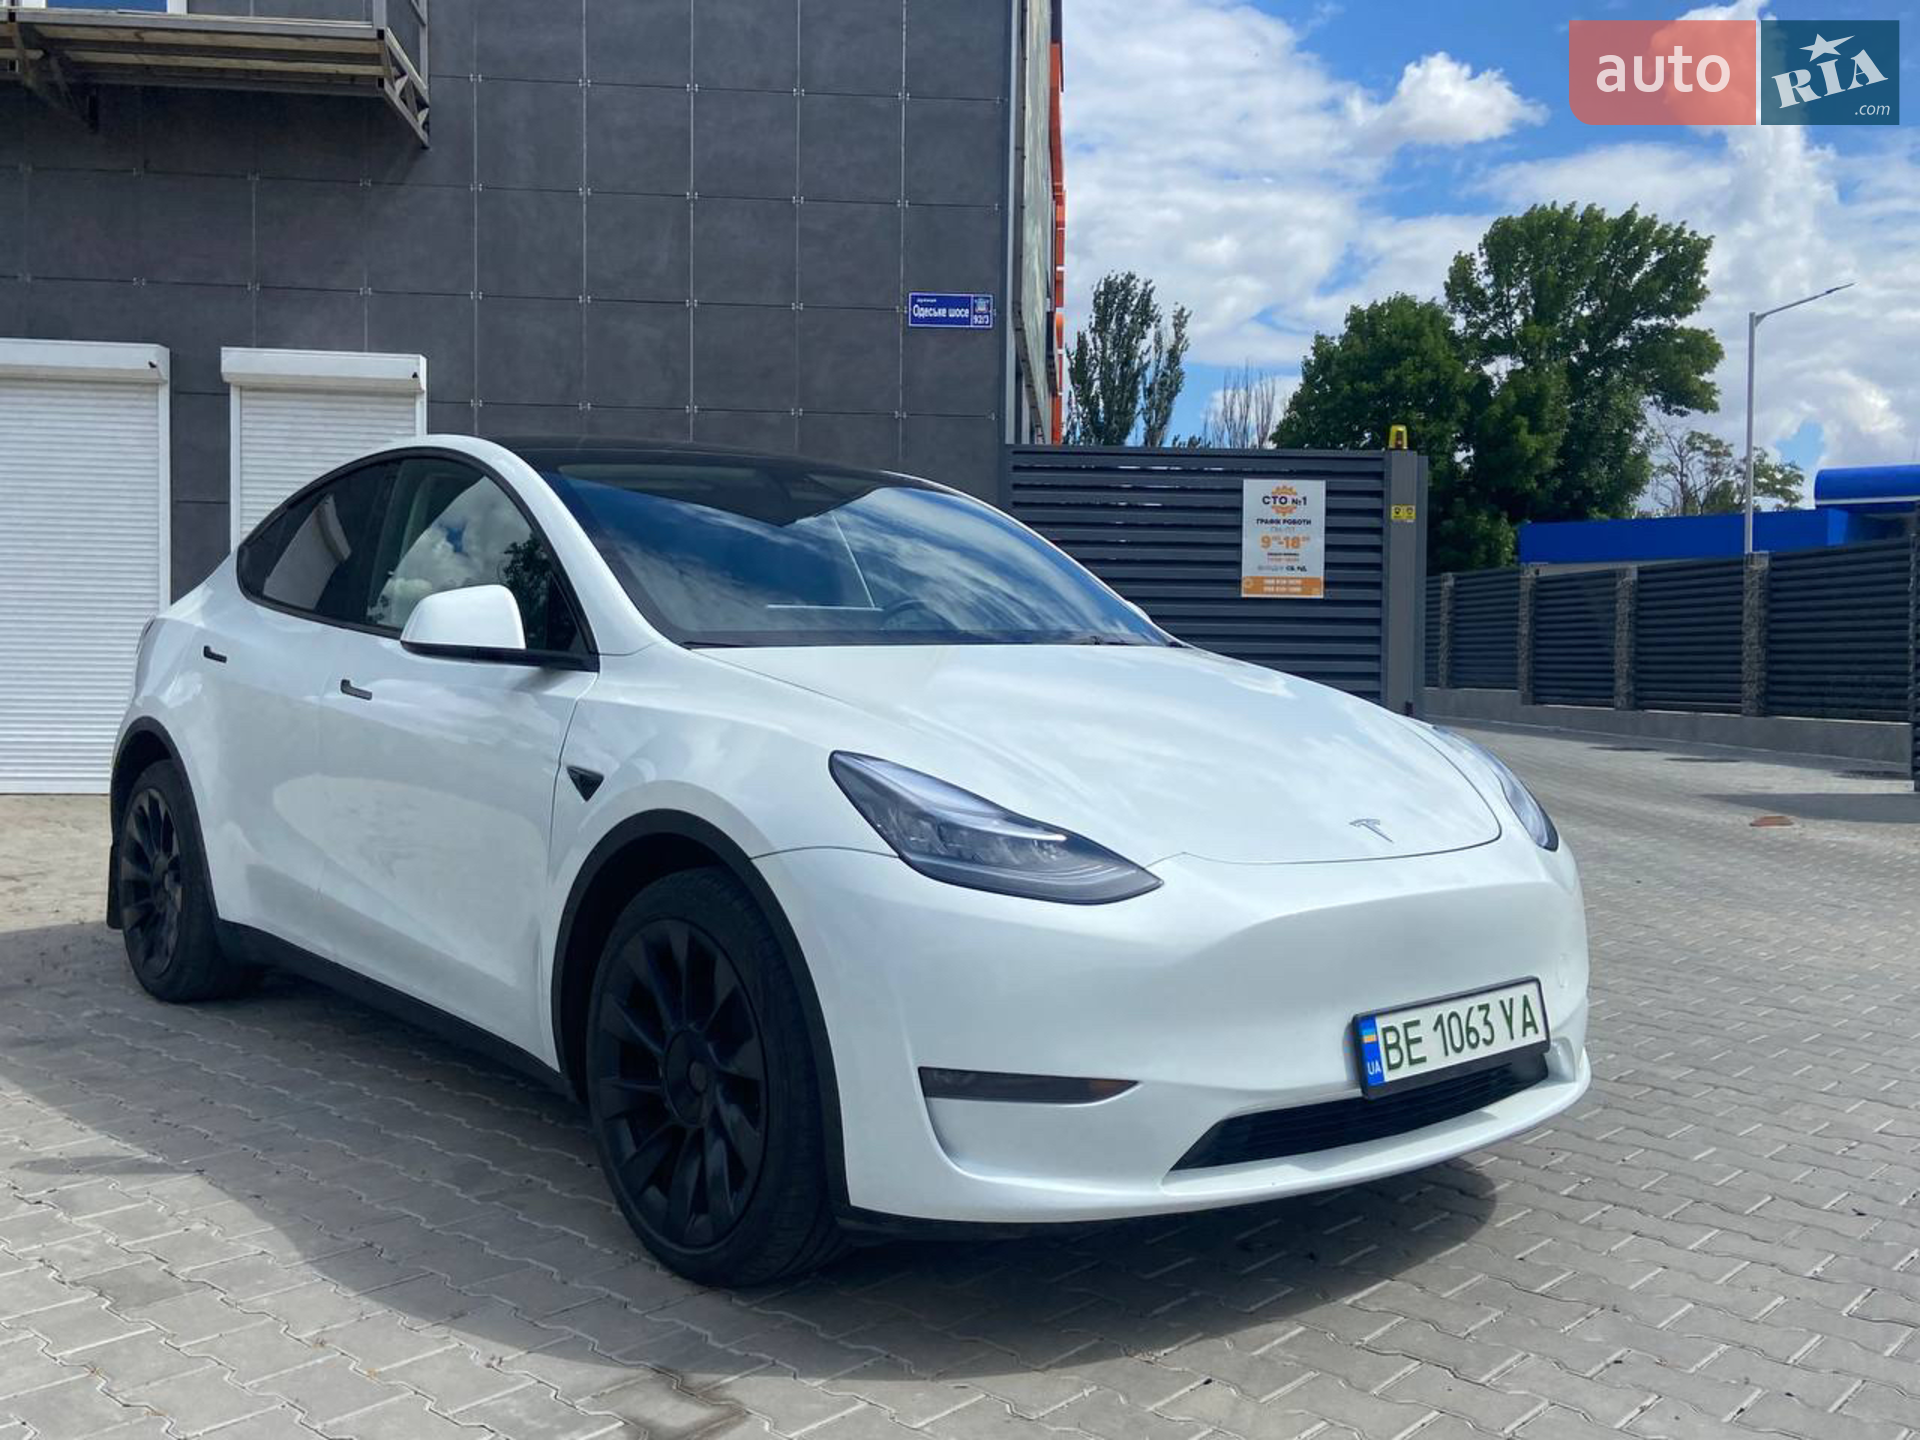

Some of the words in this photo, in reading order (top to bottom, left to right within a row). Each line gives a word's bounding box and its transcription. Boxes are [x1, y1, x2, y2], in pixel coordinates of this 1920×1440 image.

[912, 304, 947, 318] Одеське
[1262, 495, 1288, 505] СТО
[1381, 1020, 1427, 1072] BE
[1433, 1003, 1495, 1057] 1063
[1499, 994, 1539, 1041] YA
[1367, 1060, 1383, 1076] UA
